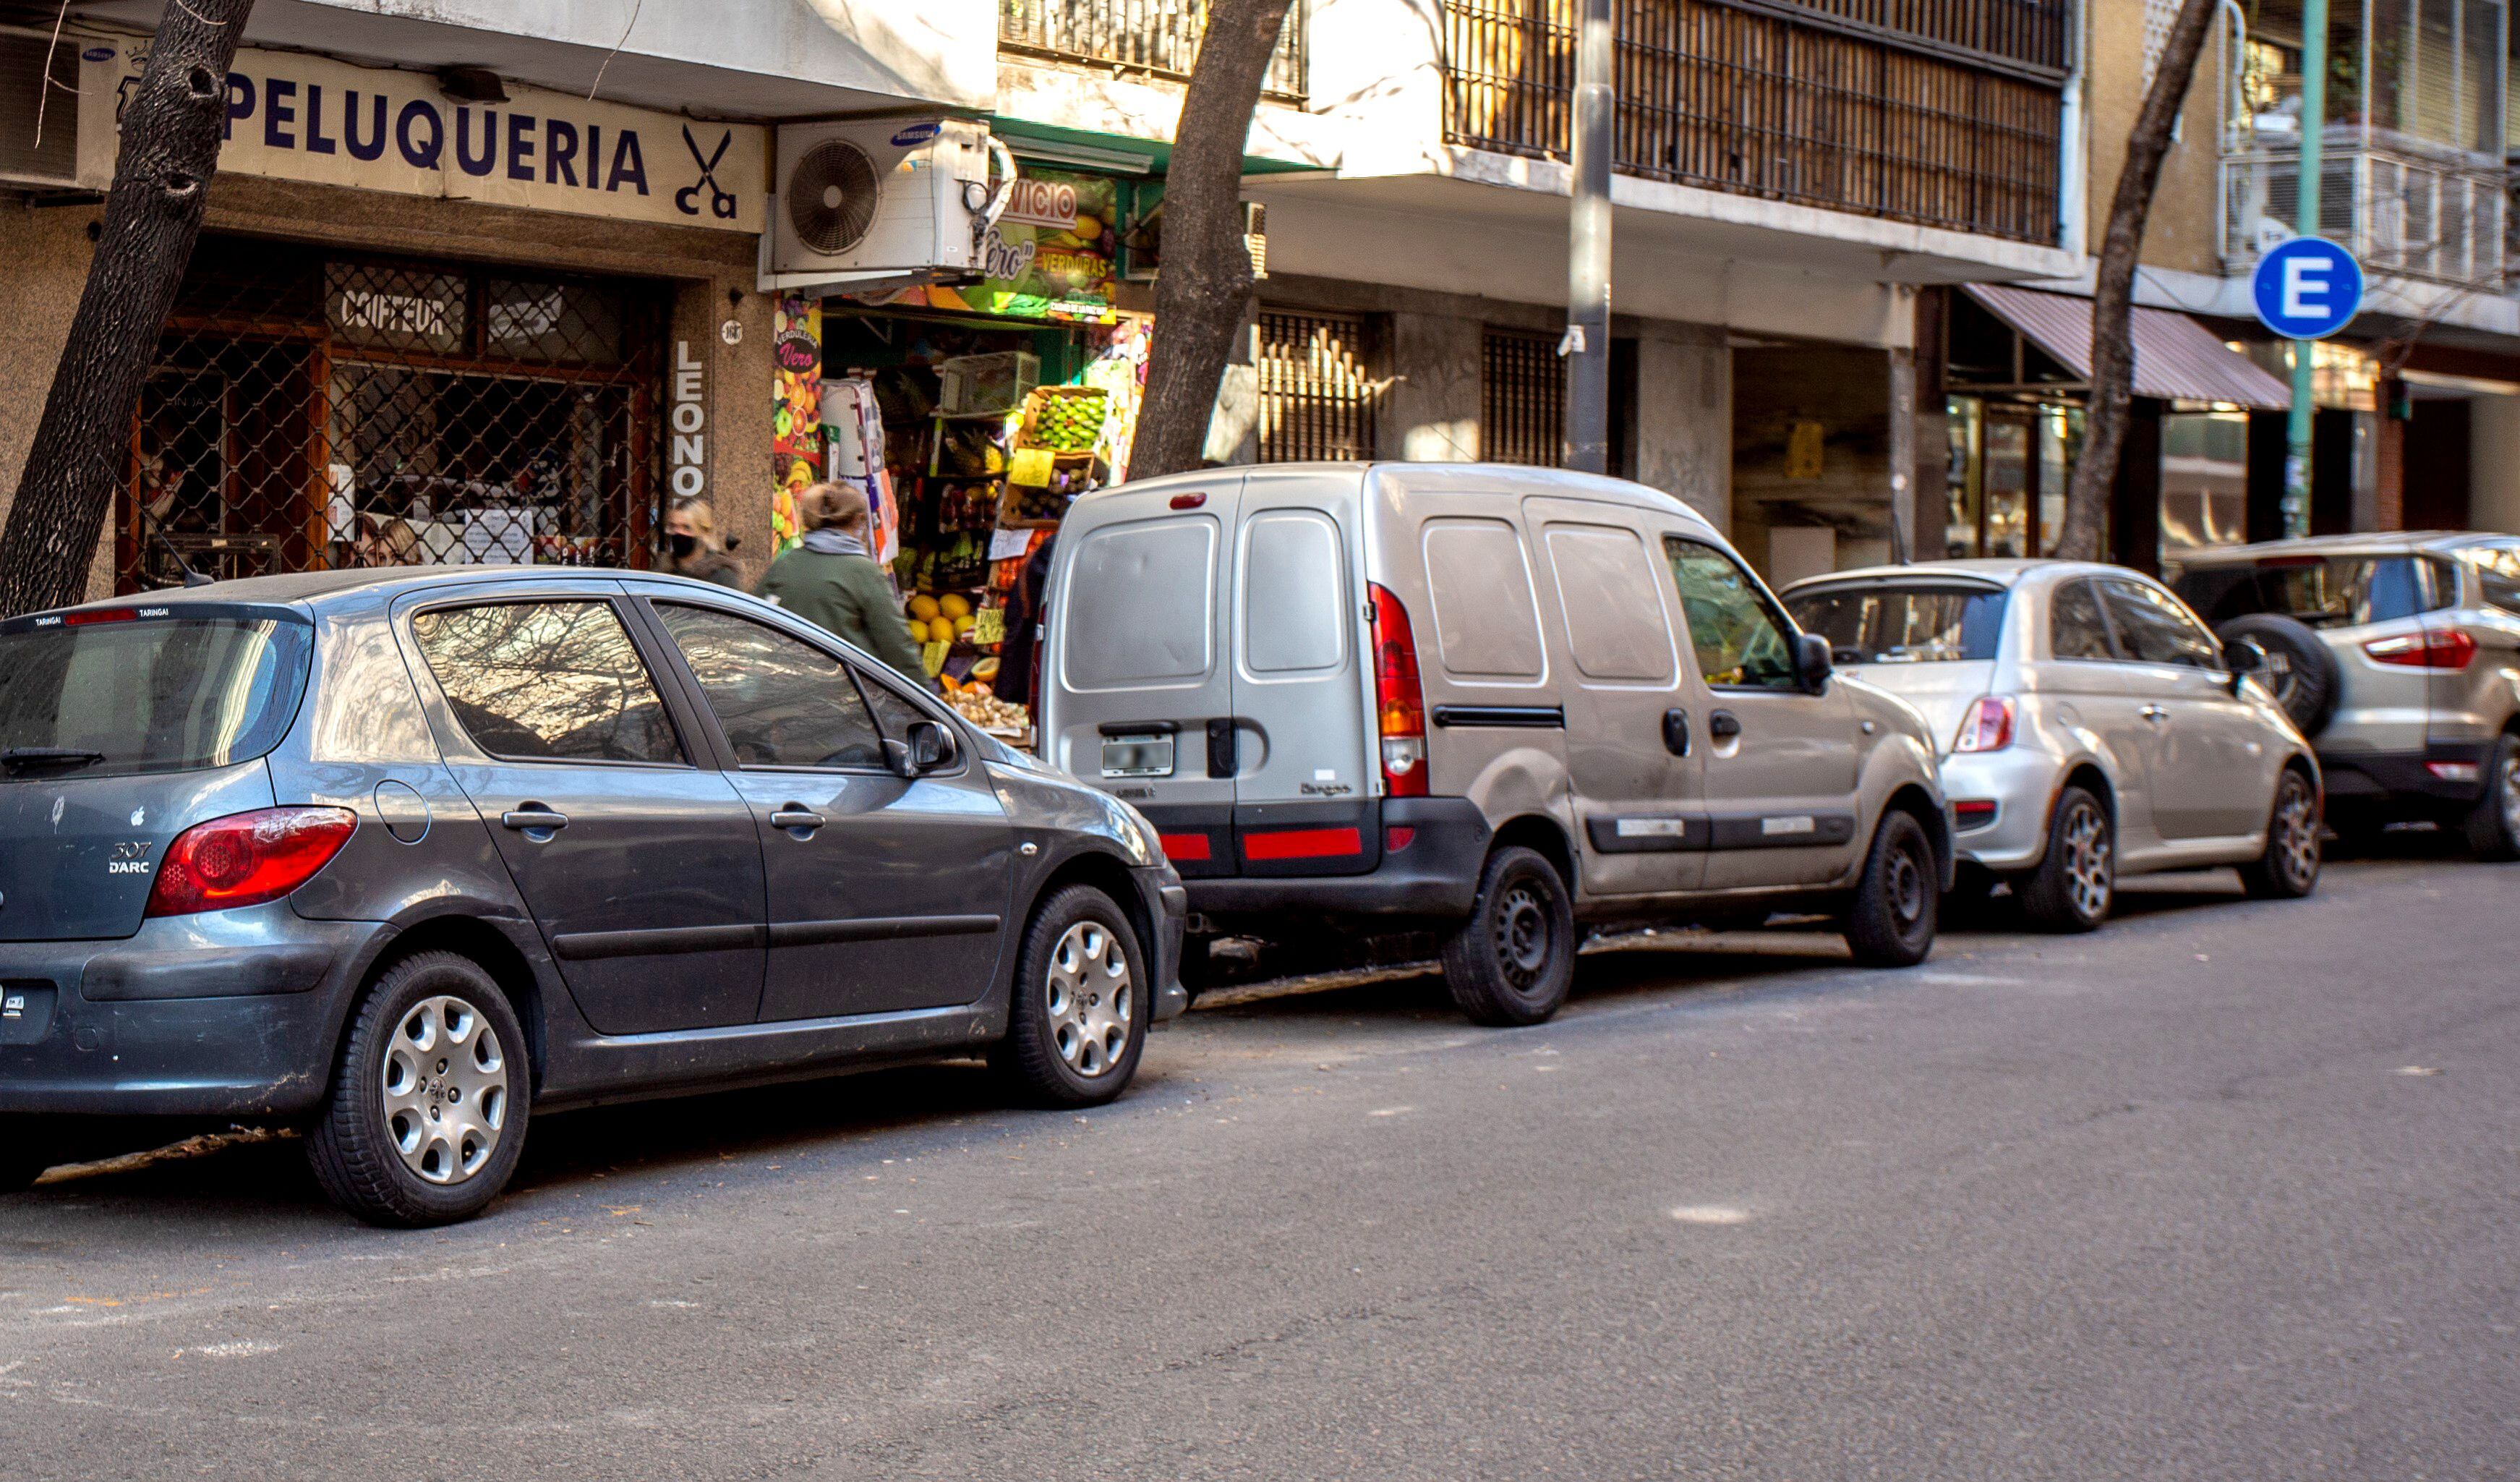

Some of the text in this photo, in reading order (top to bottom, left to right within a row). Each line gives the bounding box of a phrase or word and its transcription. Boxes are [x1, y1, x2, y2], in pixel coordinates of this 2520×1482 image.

[223, 72, 650, 197] PELUQUERIA
[2282, 257, 2334, 318] E
[341, 290, 444, 336] COIFFEUR
[780, 343, 813, 367] Vero
[672, 341, 704, 509] LEONO
[109, 861, 150, 873] D'ARC
[111, 841, 152, 859] 307
